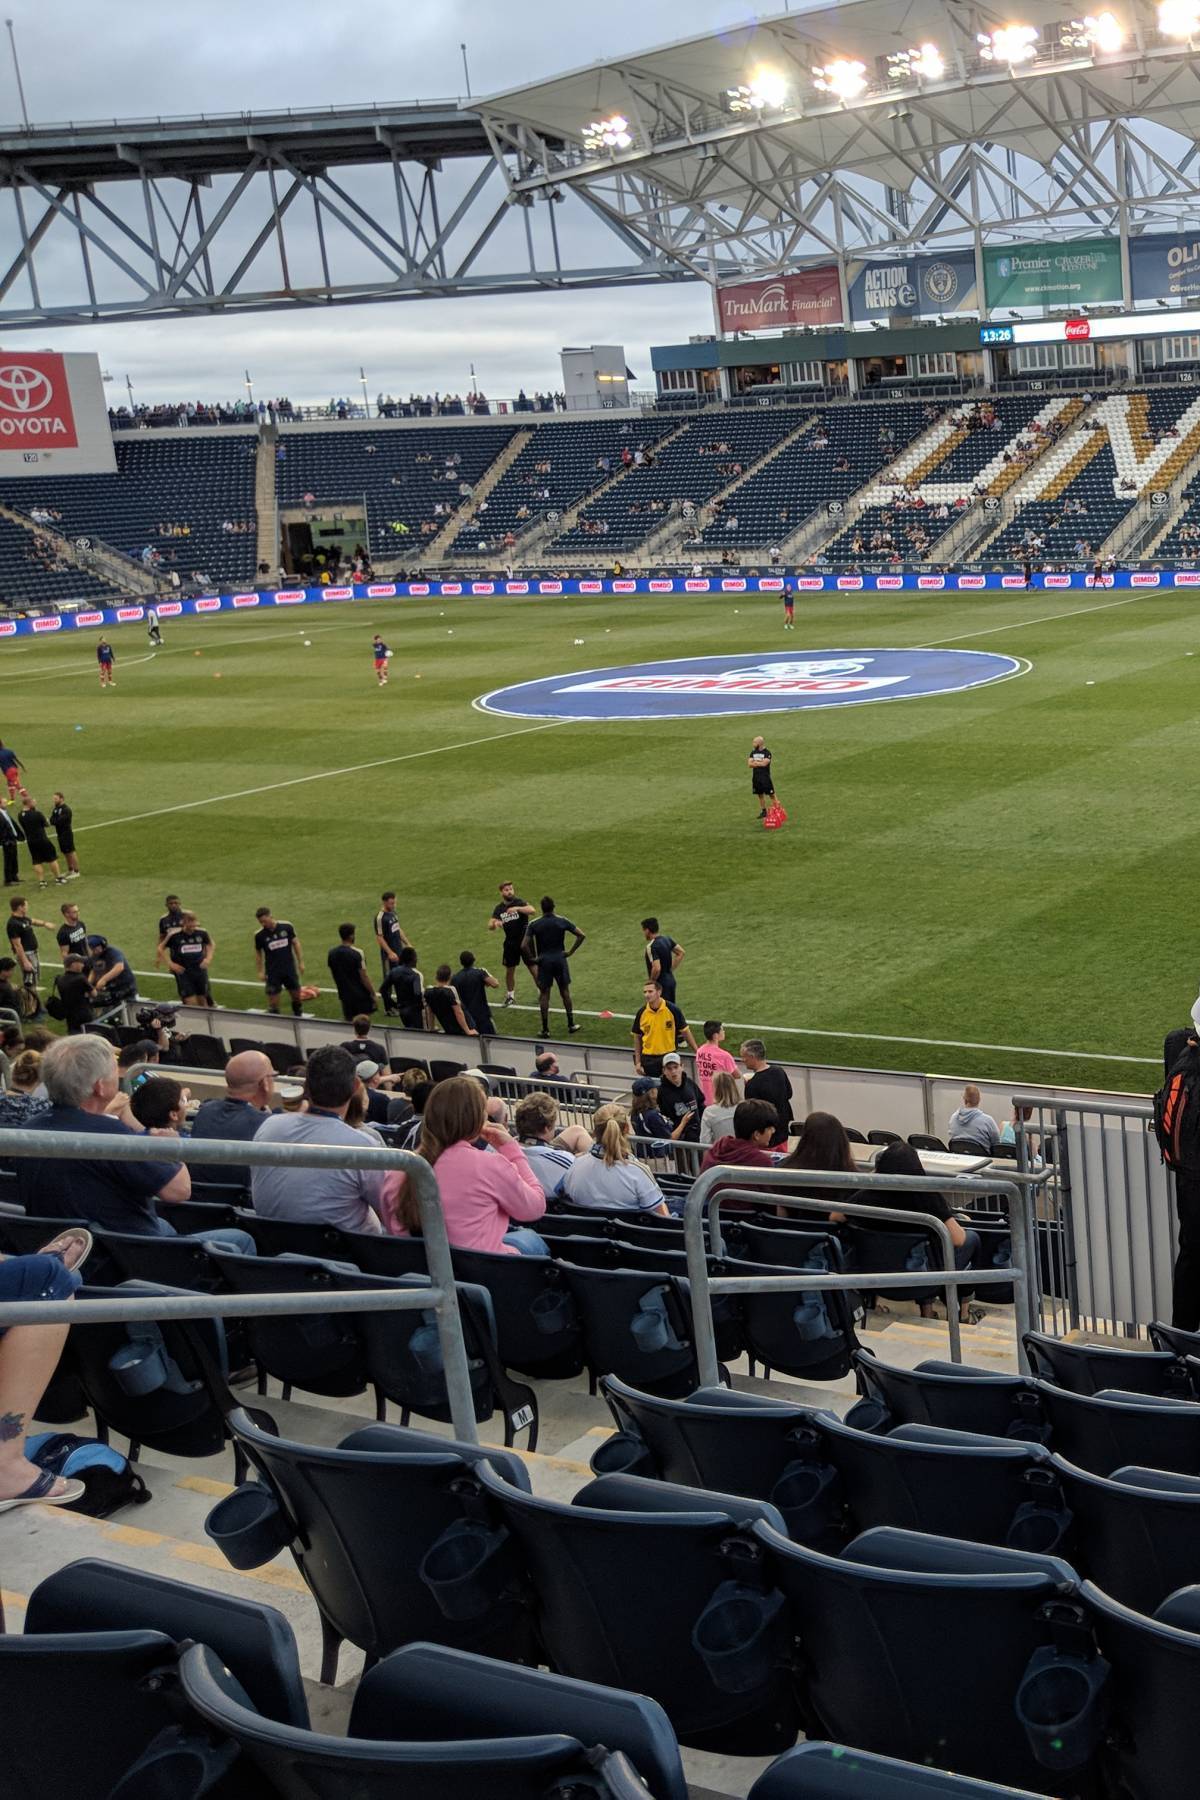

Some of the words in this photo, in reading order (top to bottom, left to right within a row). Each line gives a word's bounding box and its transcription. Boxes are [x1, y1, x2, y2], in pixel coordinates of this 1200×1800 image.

[1011, 256, 1052, 271] Premier
[864, 266, 908, 291] ACTION
[724, 296, 789, 316] TruMark
[791, 297, 833, 311] Financial
[865, 289, 898, 309] NEWS
[983, 331, 1011, 342] 13:26
[1180, 373, 1193, 381] 126
[0, 417, 67, 436] OYOTA
[1132, 575, 1157, 584] BIMBO
[600, 678, 869, 691] BIMBO
[698, 1052, 712, 1061] MLS
[518, 1409, 529, 1425] M
